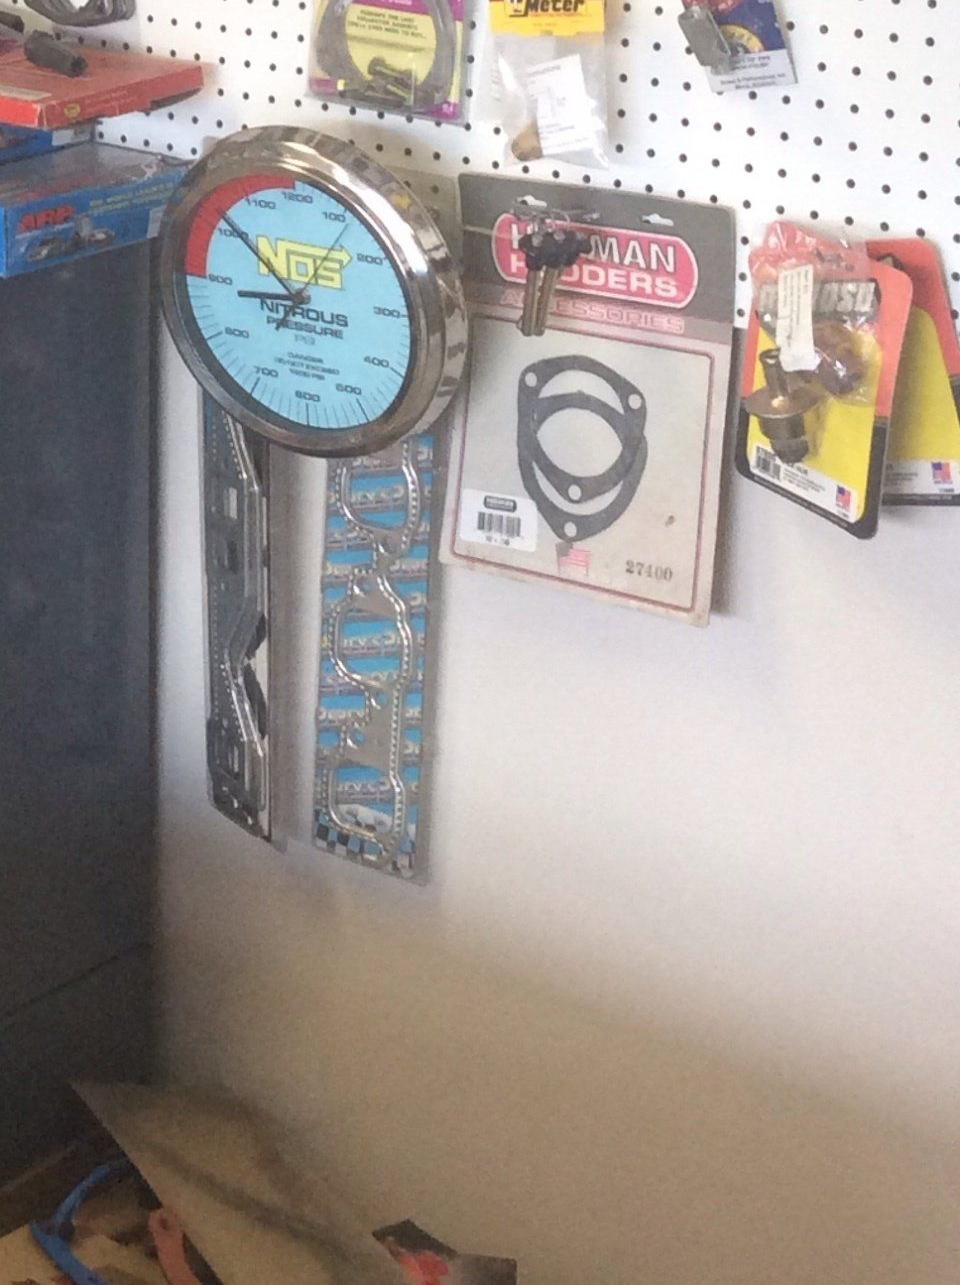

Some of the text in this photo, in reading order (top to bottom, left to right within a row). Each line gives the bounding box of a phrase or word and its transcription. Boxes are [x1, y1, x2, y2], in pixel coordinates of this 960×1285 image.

[245, 198, 277, 210] 1100
[280, 191, 315, 204] 1200
[322, 210, 347, 223] 100
[511, 223, 676, 274] HMAN
[255, 233, 353, 291] NOS
[356, 252, 384, 265] 200
[510, 254, 679, 299] HDDERS
[260, 298, 349, 328] NITROUS
[373, 305, 401, 319] 300
[266, 316, 344, 340] PRESSURE
[363, 355, 390, 368] 400
[253, 365, 279, 379] 700
